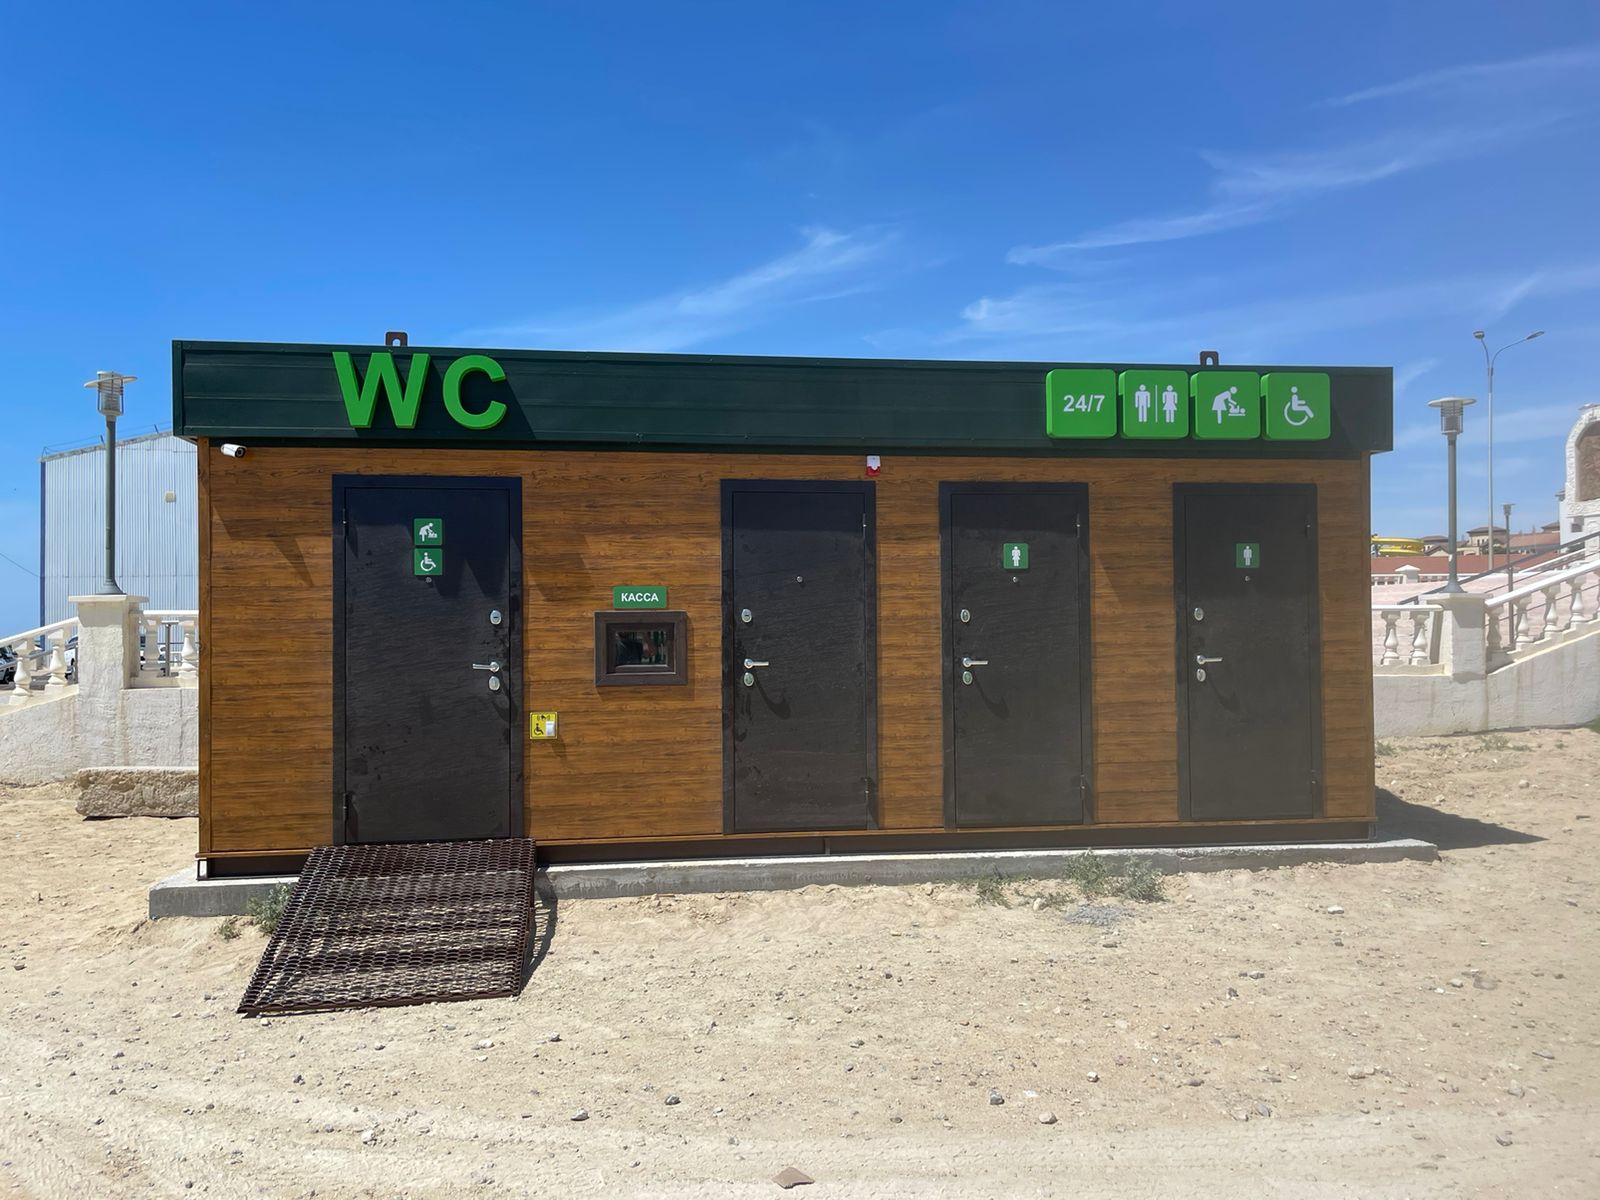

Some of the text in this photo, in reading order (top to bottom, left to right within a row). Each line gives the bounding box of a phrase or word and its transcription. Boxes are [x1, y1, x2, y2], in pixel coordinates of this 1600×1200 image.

[332, 352, 507, 430] WC
[1063, 395, 1105, 412] 24/7
[621, 593, 659, 602] КАССА
